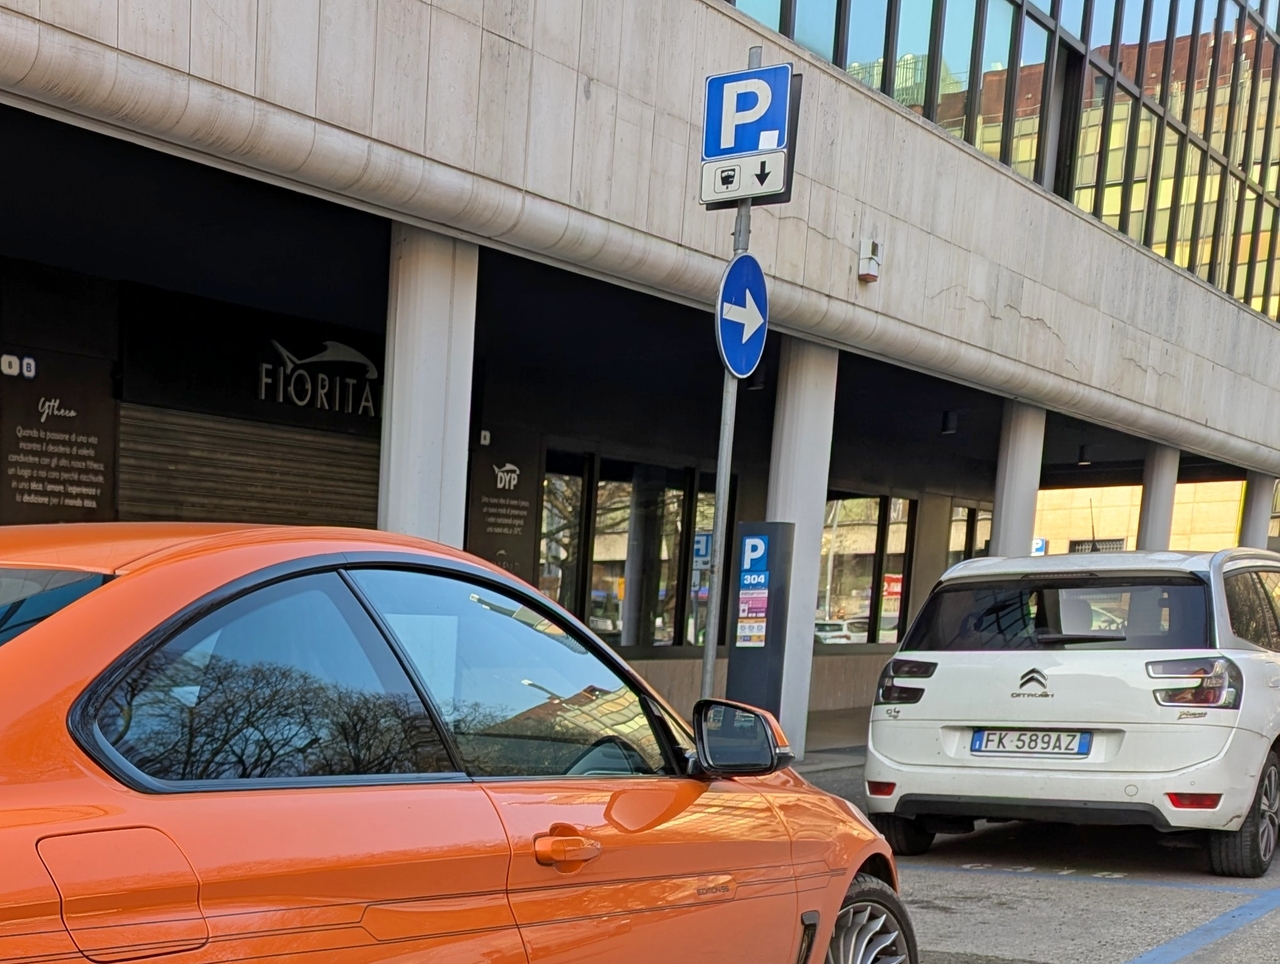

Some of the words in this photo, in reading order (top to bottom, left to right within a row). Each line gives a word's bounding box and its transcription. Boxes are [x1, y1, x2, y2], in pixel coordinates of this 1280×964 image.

[720, 79, 772, 149] P
[259, 363, 375, 417] FIORITA
[496, 472, 518, 490] DYP
[743, 538, 765, 569] P
[743, 574, 765, 584] 304
[984, 732, 1009, 749] FK
[1015, 733, 1077, 751] 589AZ
